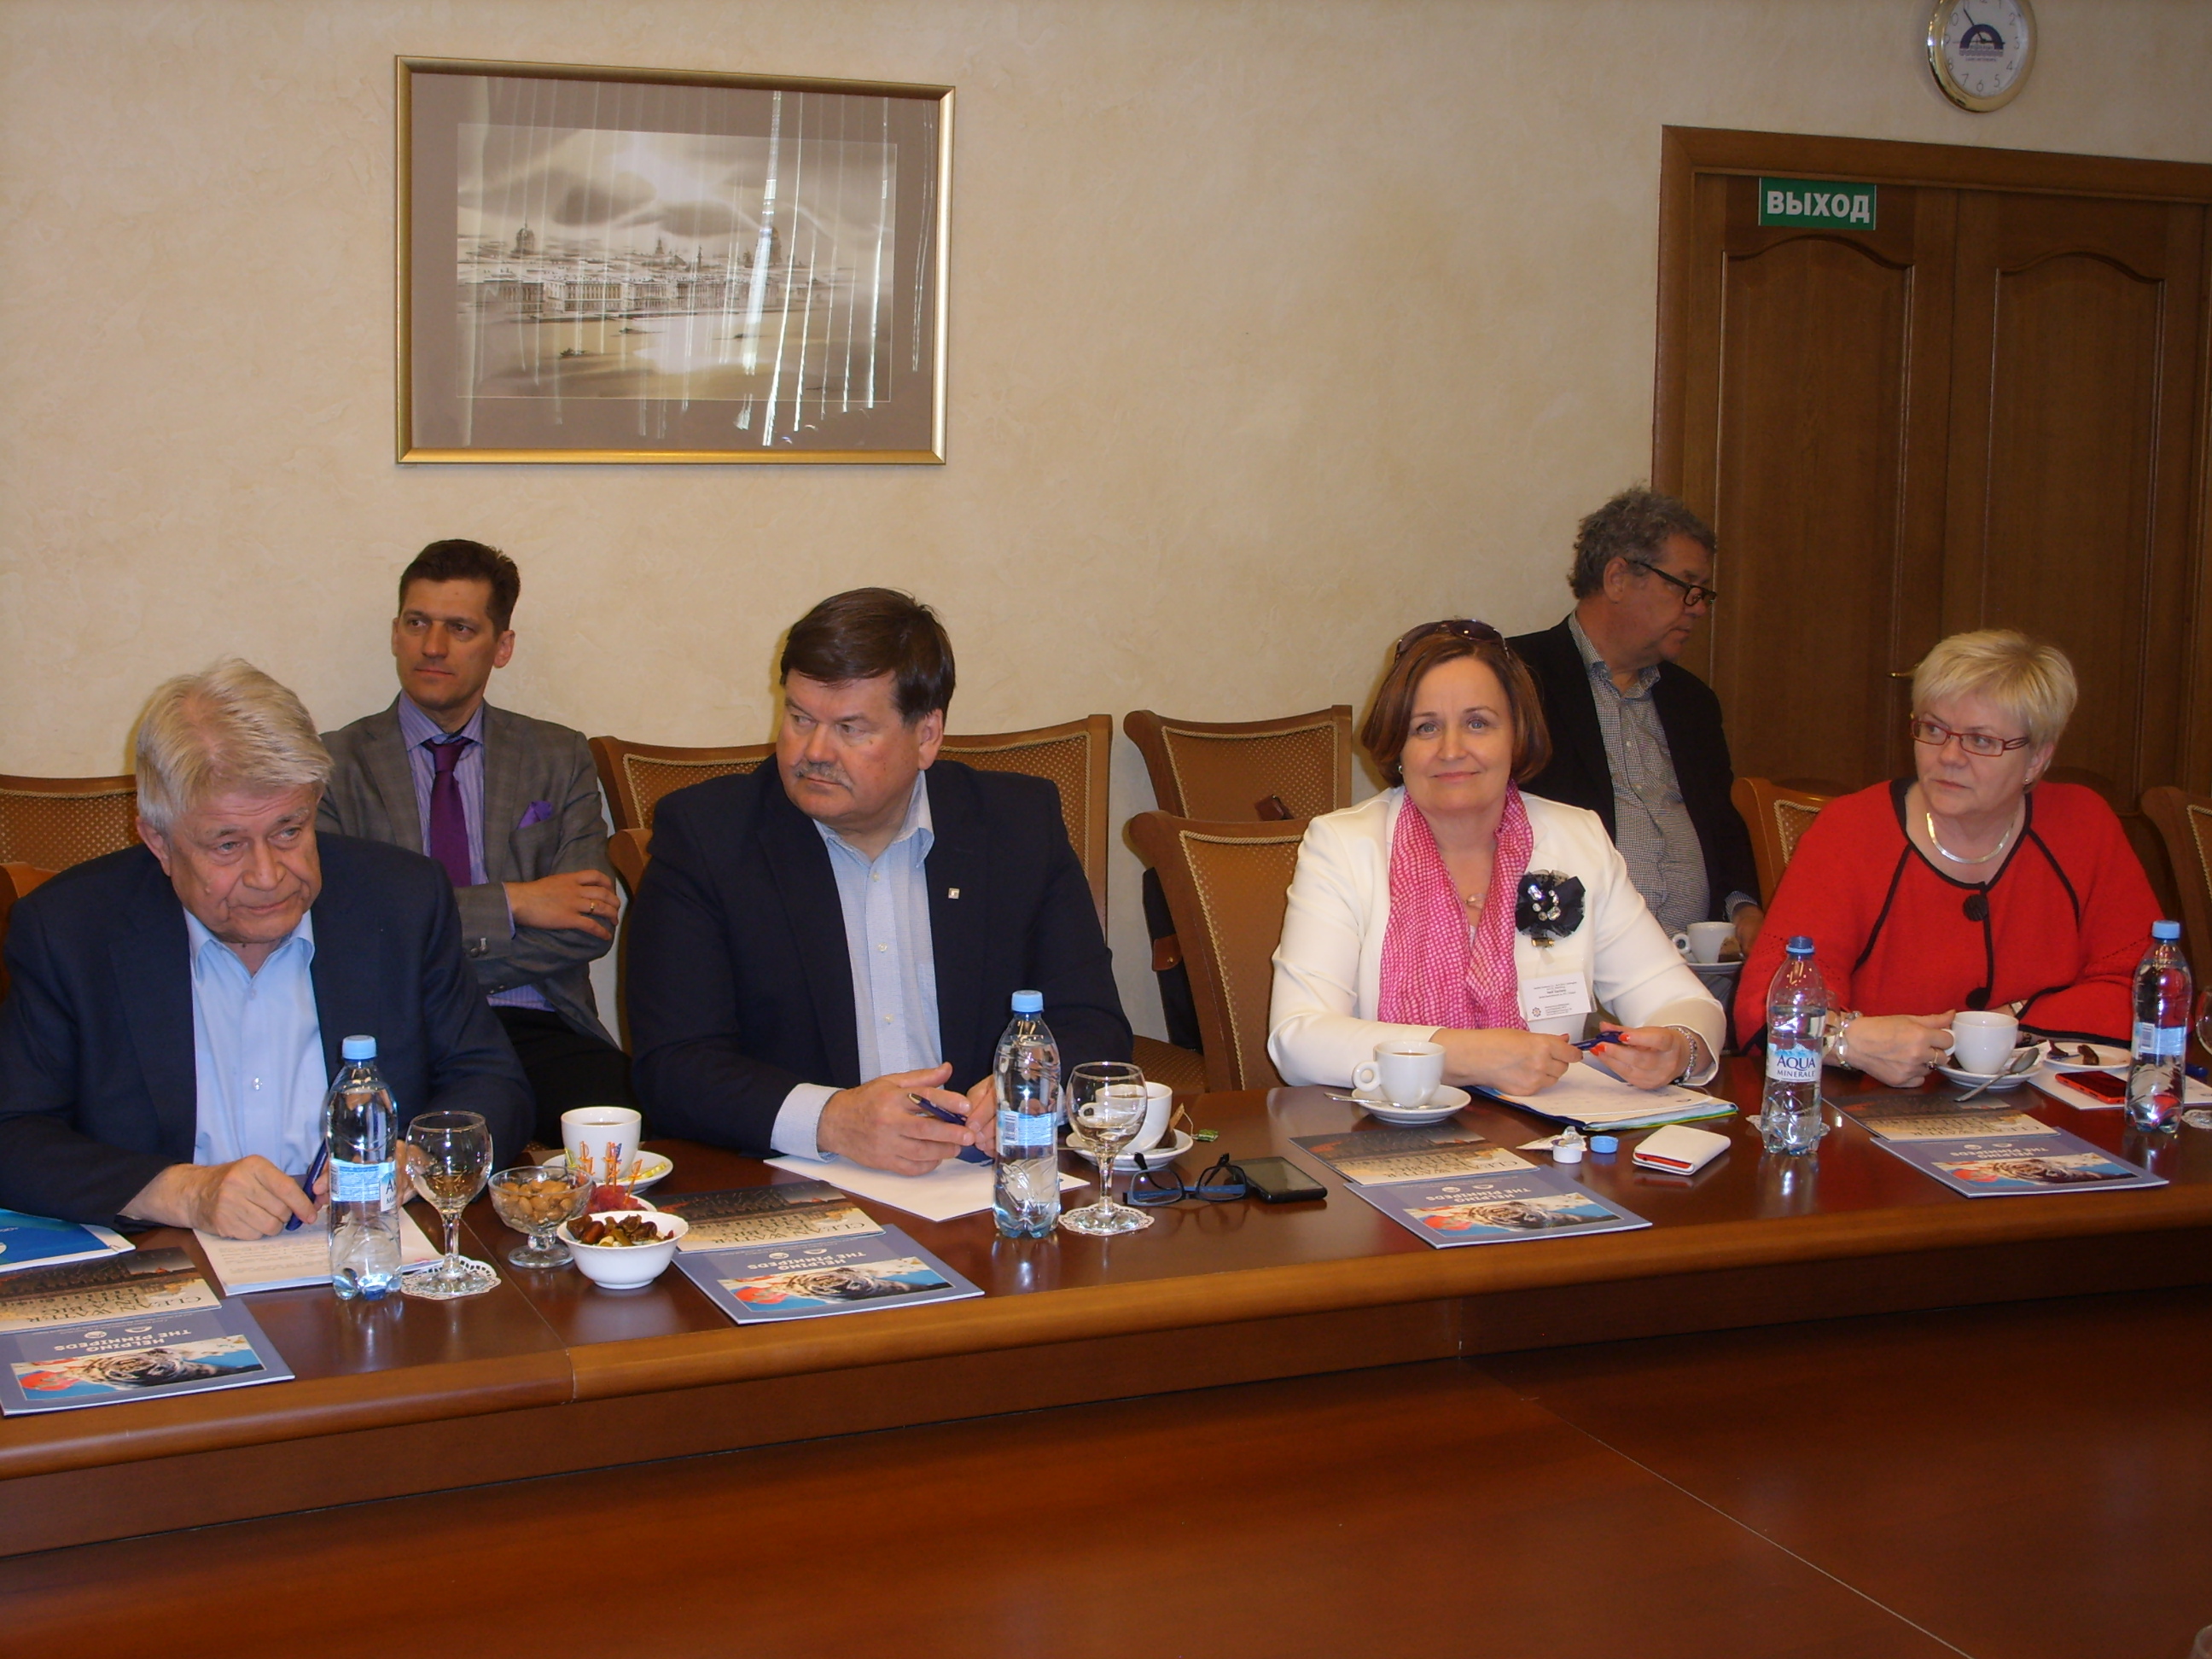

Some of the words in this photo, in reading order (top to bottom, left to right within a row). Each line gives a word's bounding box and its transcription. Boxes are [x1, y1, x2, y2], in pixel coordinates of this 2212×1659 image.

[2008, 12, 2016, 26] 2
[2014, 36, 2020, 49] 3
[2006, 61, 2012, 70] 4
[1961, 73, 1969, 86] 7
[1976, 79, 1983, 91] 6
[1994, 74, 2000, 87] 5
[1767, 190, 1870, 224] ВЫХОД
[1777, 1055, 1816, 1071] AQUA
[1777, 1069, 1815, 1078] MINERALE
[1425, 1190, 1501, 1201] PINNIPEDS
[1454, 1194, 1515, 1202] HELPING
[793, 1222, 864, 1236] CLEAN
[713, 1232, 787, 1244] WATER
[747, 1255, 833, 1270] PINNIPEDS
[777, 1259, 847, 1271] HELPING
[119, 1296, 201, 1313] CLEAN
[26, 1309, 112, 1323] WATER
[158, 1329, 191, 1338] THE
[54, 1335, 153, 1351] PINNIPEDS
[85, 1338, 165, 1352] HELPING
